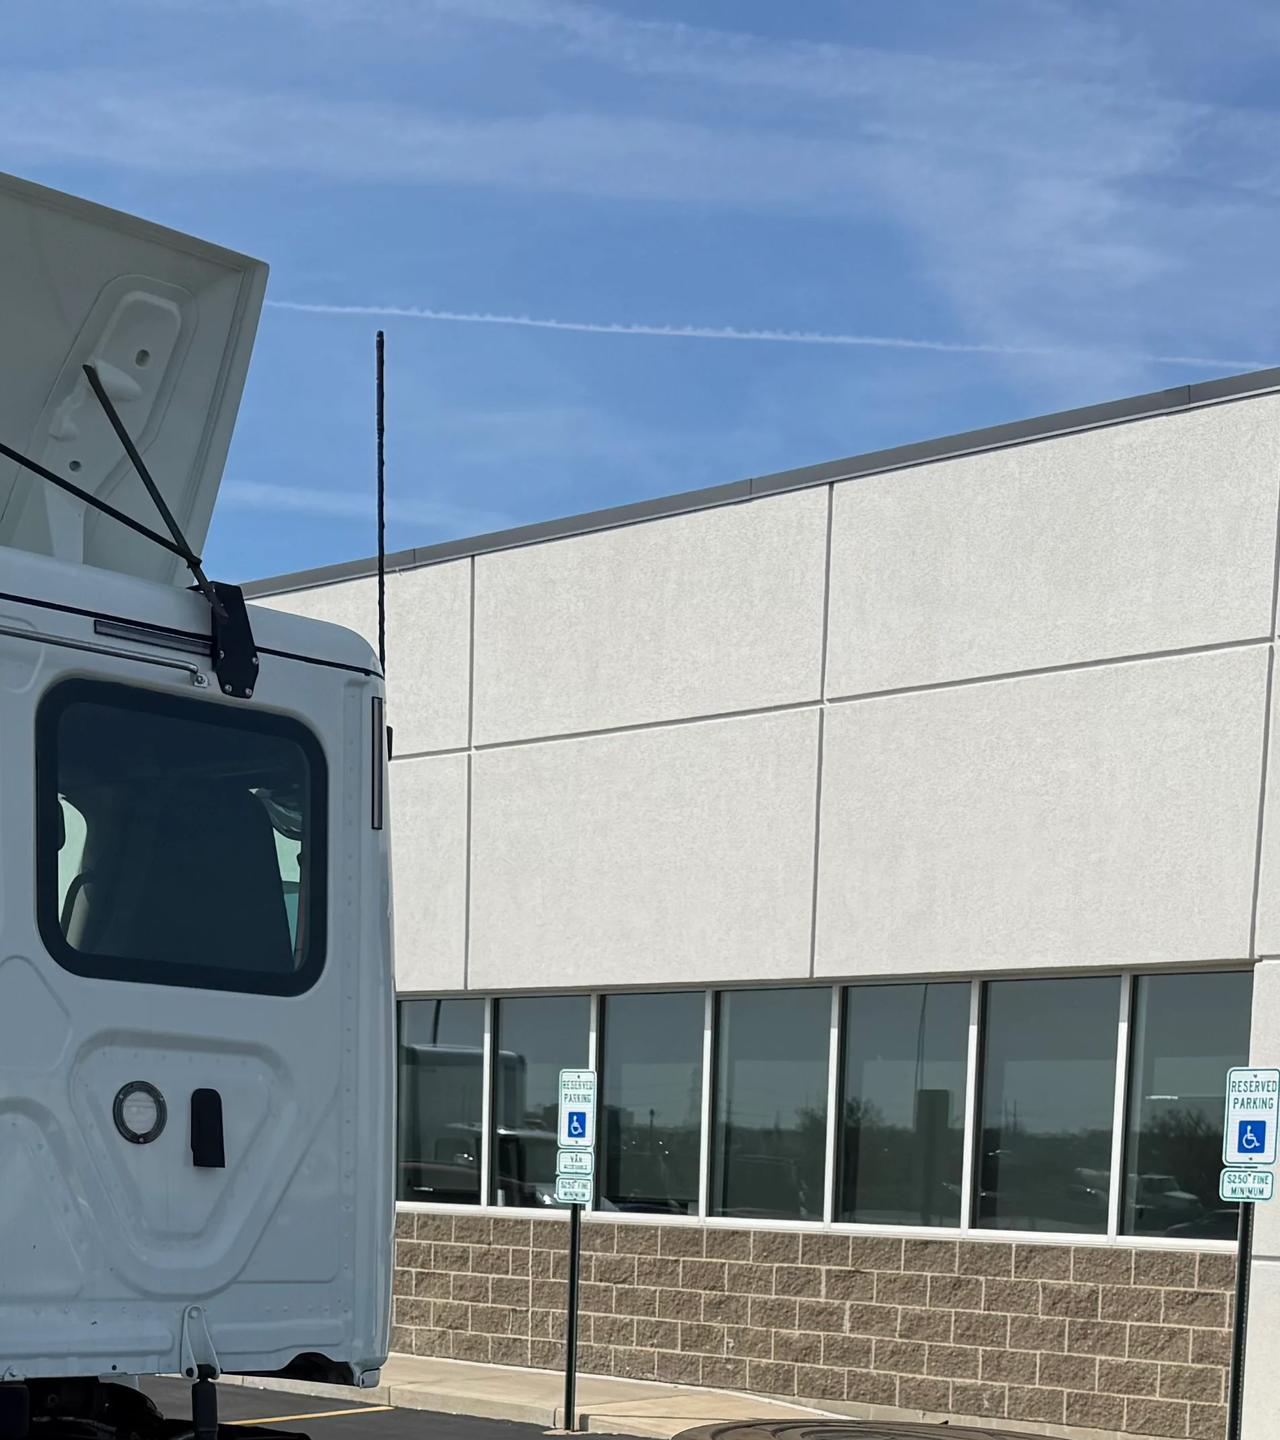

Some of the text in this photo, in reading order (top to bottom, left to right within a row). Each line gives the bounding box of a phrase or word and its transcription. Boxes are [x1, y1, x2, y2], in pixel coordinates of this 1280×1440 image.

[1231, 1080, 1277, 1093] RESERVED
[564, 1093, 592, 1104] PARKING
[1233, 1097, 1274, 1110] PARKING
[570, 1155, 583, 1163] VAN
[1227, 1173, 1269, 1184] $250 FINE
[1231, 1187, 1264, 1196] MINIMUM
